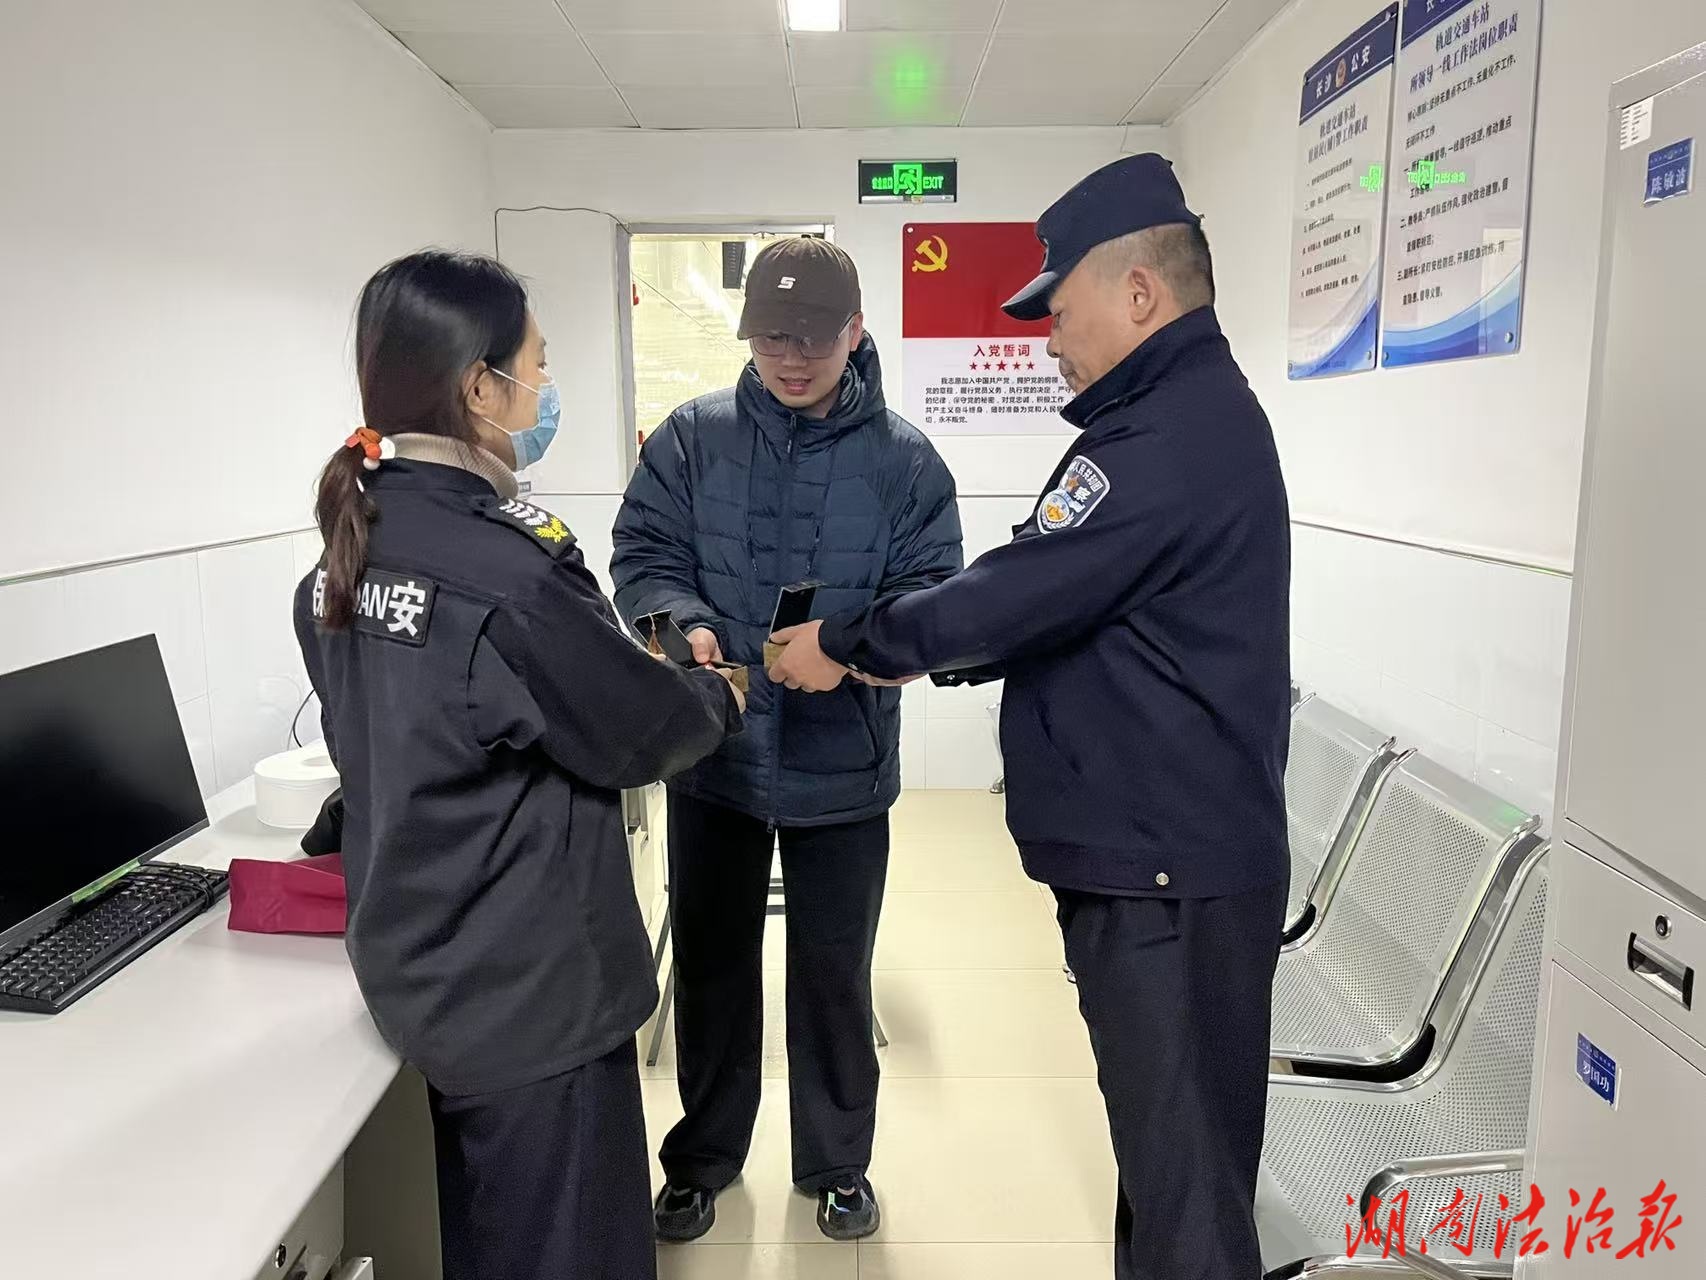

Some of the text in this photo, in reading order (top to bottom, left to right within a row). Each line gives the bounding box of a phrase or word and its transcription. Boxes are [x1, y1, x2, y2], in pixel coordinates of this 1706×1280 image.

[1352, 45, 1370, 72] 公安
[923, 176, 944, 188] EXIT
[974, 344, 1030, 357] 入党誓词
